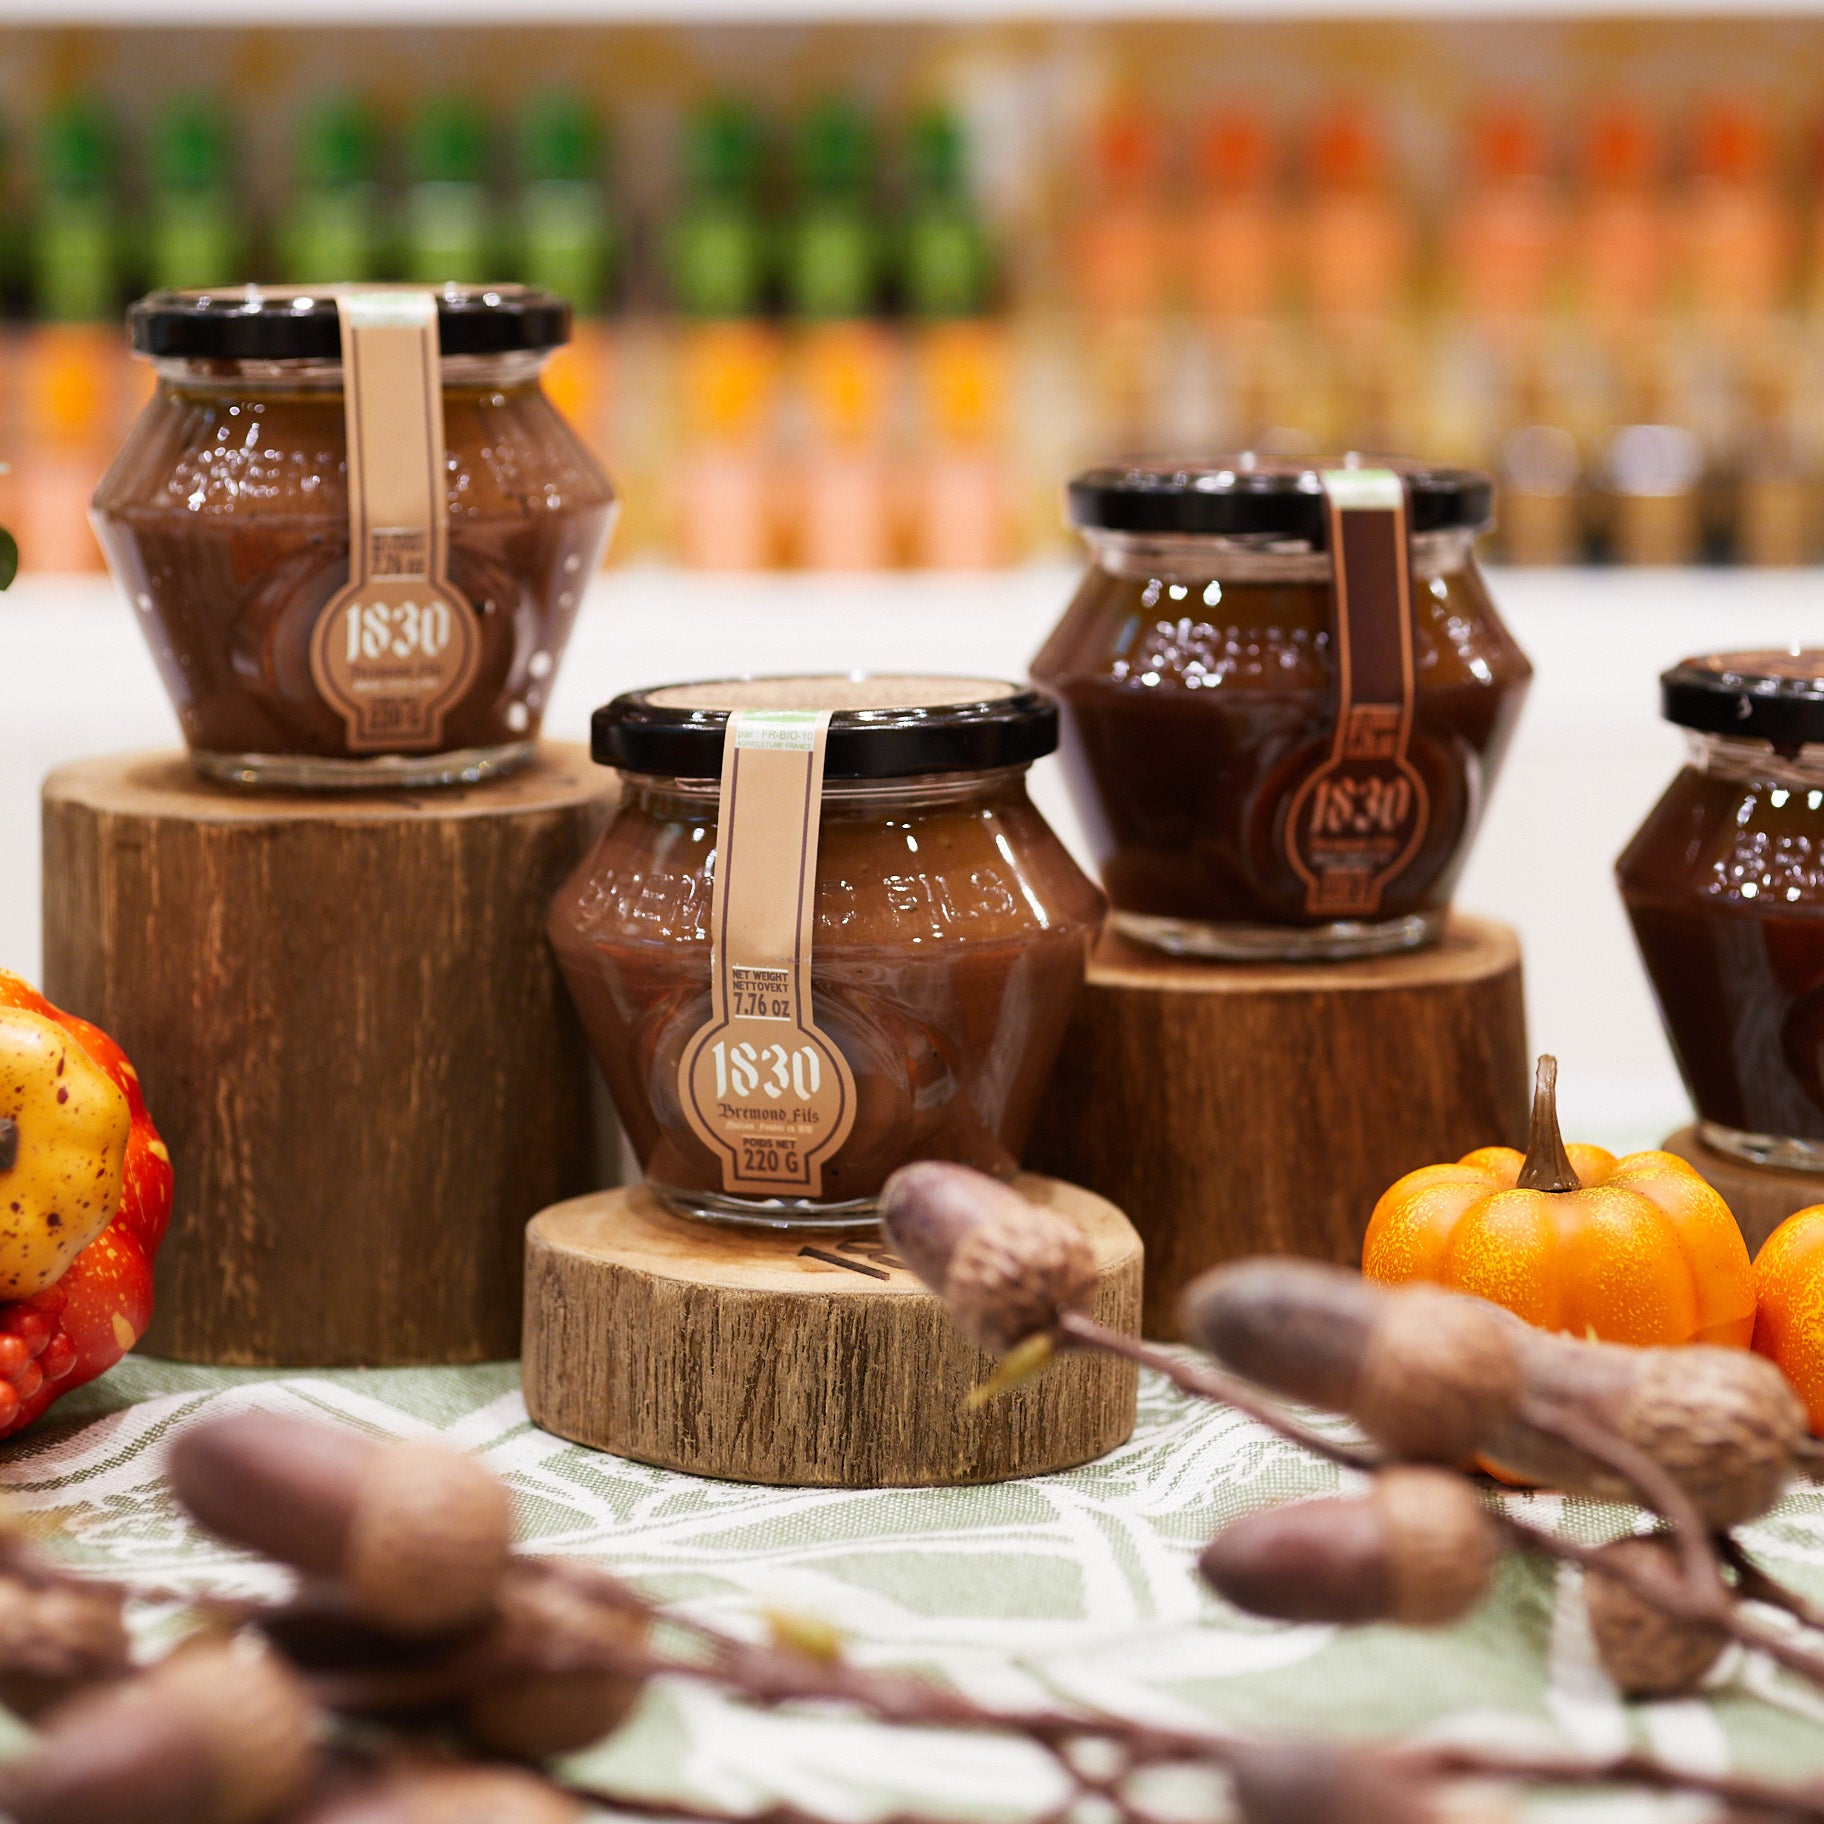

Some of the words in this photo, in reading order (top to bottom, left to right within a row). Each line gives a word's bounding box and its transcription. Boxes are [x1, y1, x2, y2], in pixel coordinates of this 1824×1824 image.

[346, 600, 452, 664] 1830
[732, 969, 749, 980] NET
[752, 970, 789, 982] WEIGHT
[732, 980, 789, 993] NETTOVEKT
[733, 991, 767, 1016] 7.76
[711, 1040, 821, 1101] 1830
[742, 1137, 773, 1149] POIDS
[775, 1139, 797, 1150] NET
[744, 1148, 778, 1172] 220
[785, 1151, 799, 1174] G
